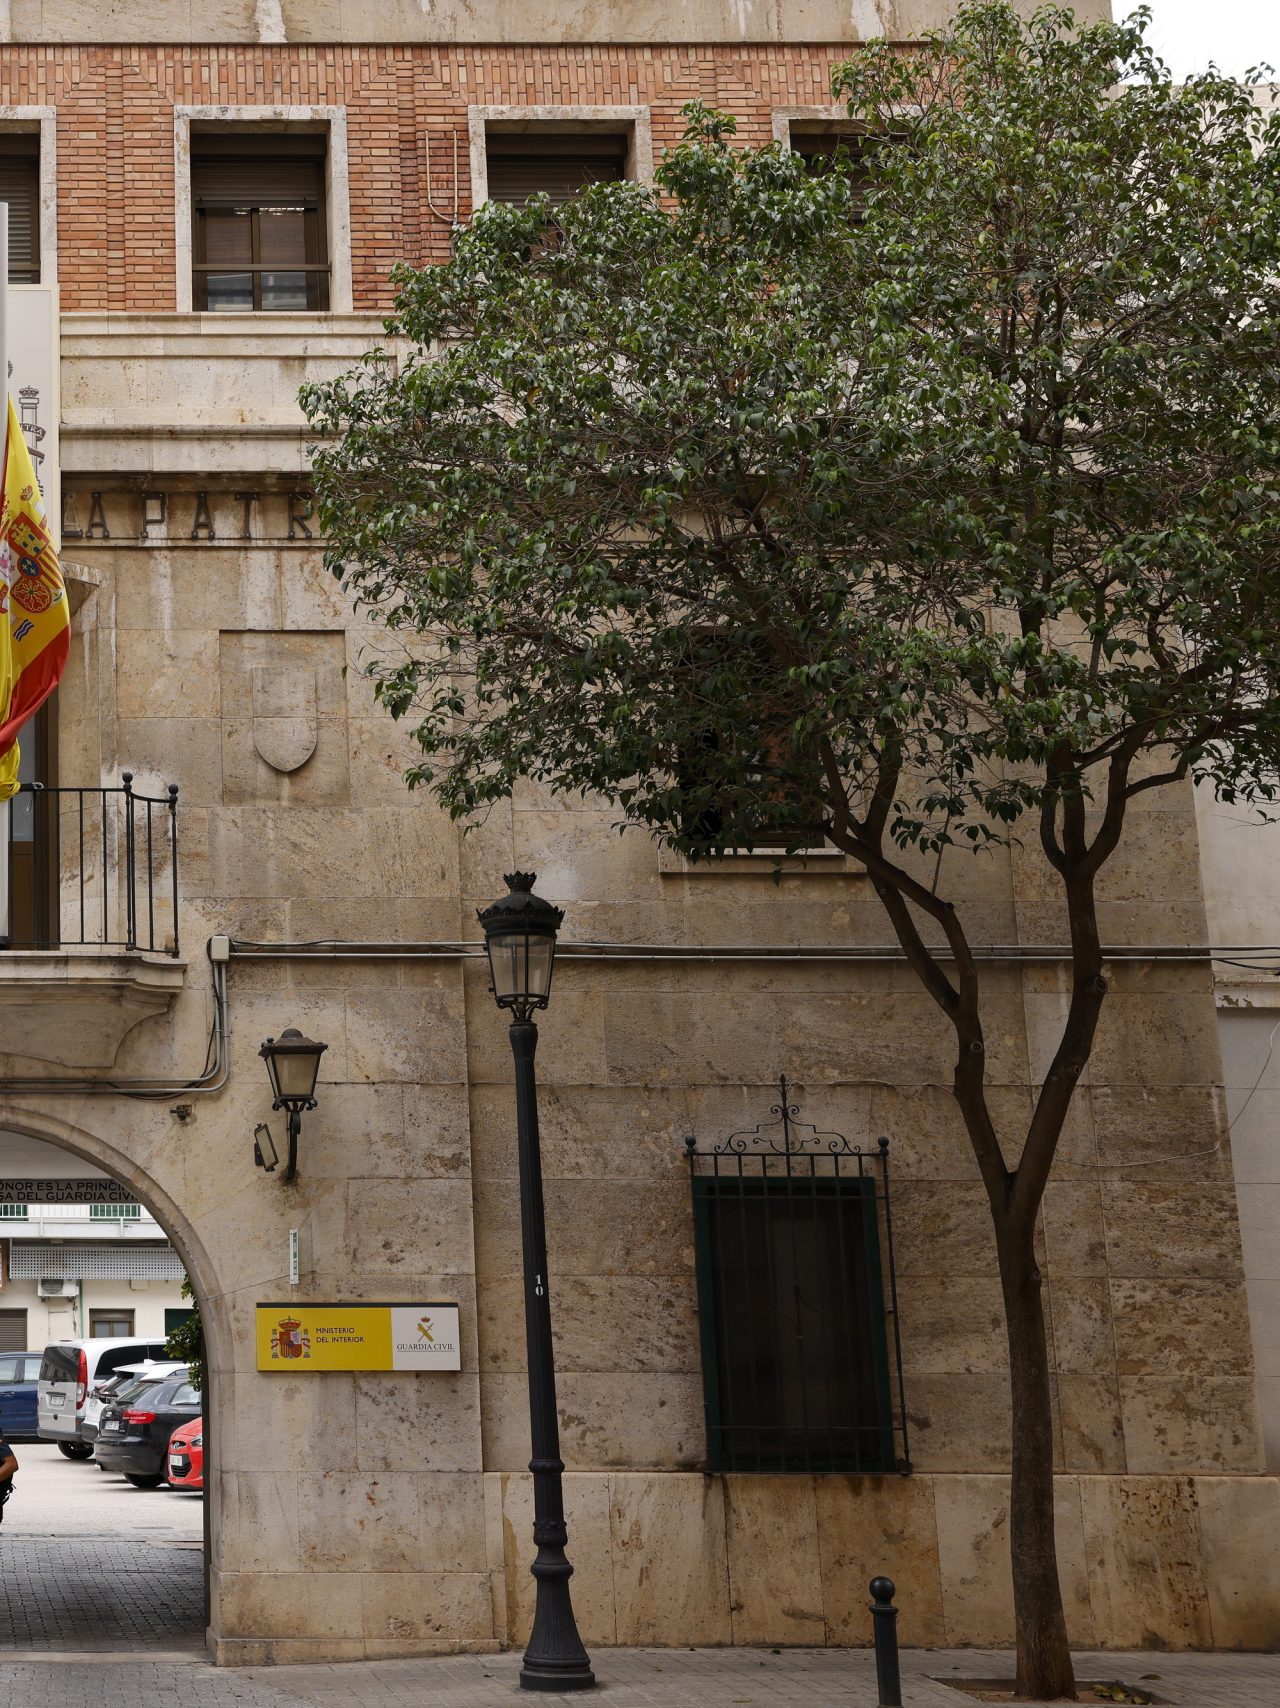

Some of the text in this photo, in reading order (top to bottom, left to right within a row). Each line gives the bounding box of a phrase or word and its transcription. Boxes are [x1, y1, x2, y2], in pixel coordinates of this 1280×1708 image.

[61, 491, 109, 538] LA
[141, 491, 313, 539] PATR
[37, 1181, 54, 1191] ES
[56, 1181, 73, 1191] LA
[77, 1182, 125, 1191] PRINCI
[17, 1191, 43, 1201] DEL
[46, 1191, 106, 1201] GUARDIA
[109, 1191, 138, 1201] CIVI
